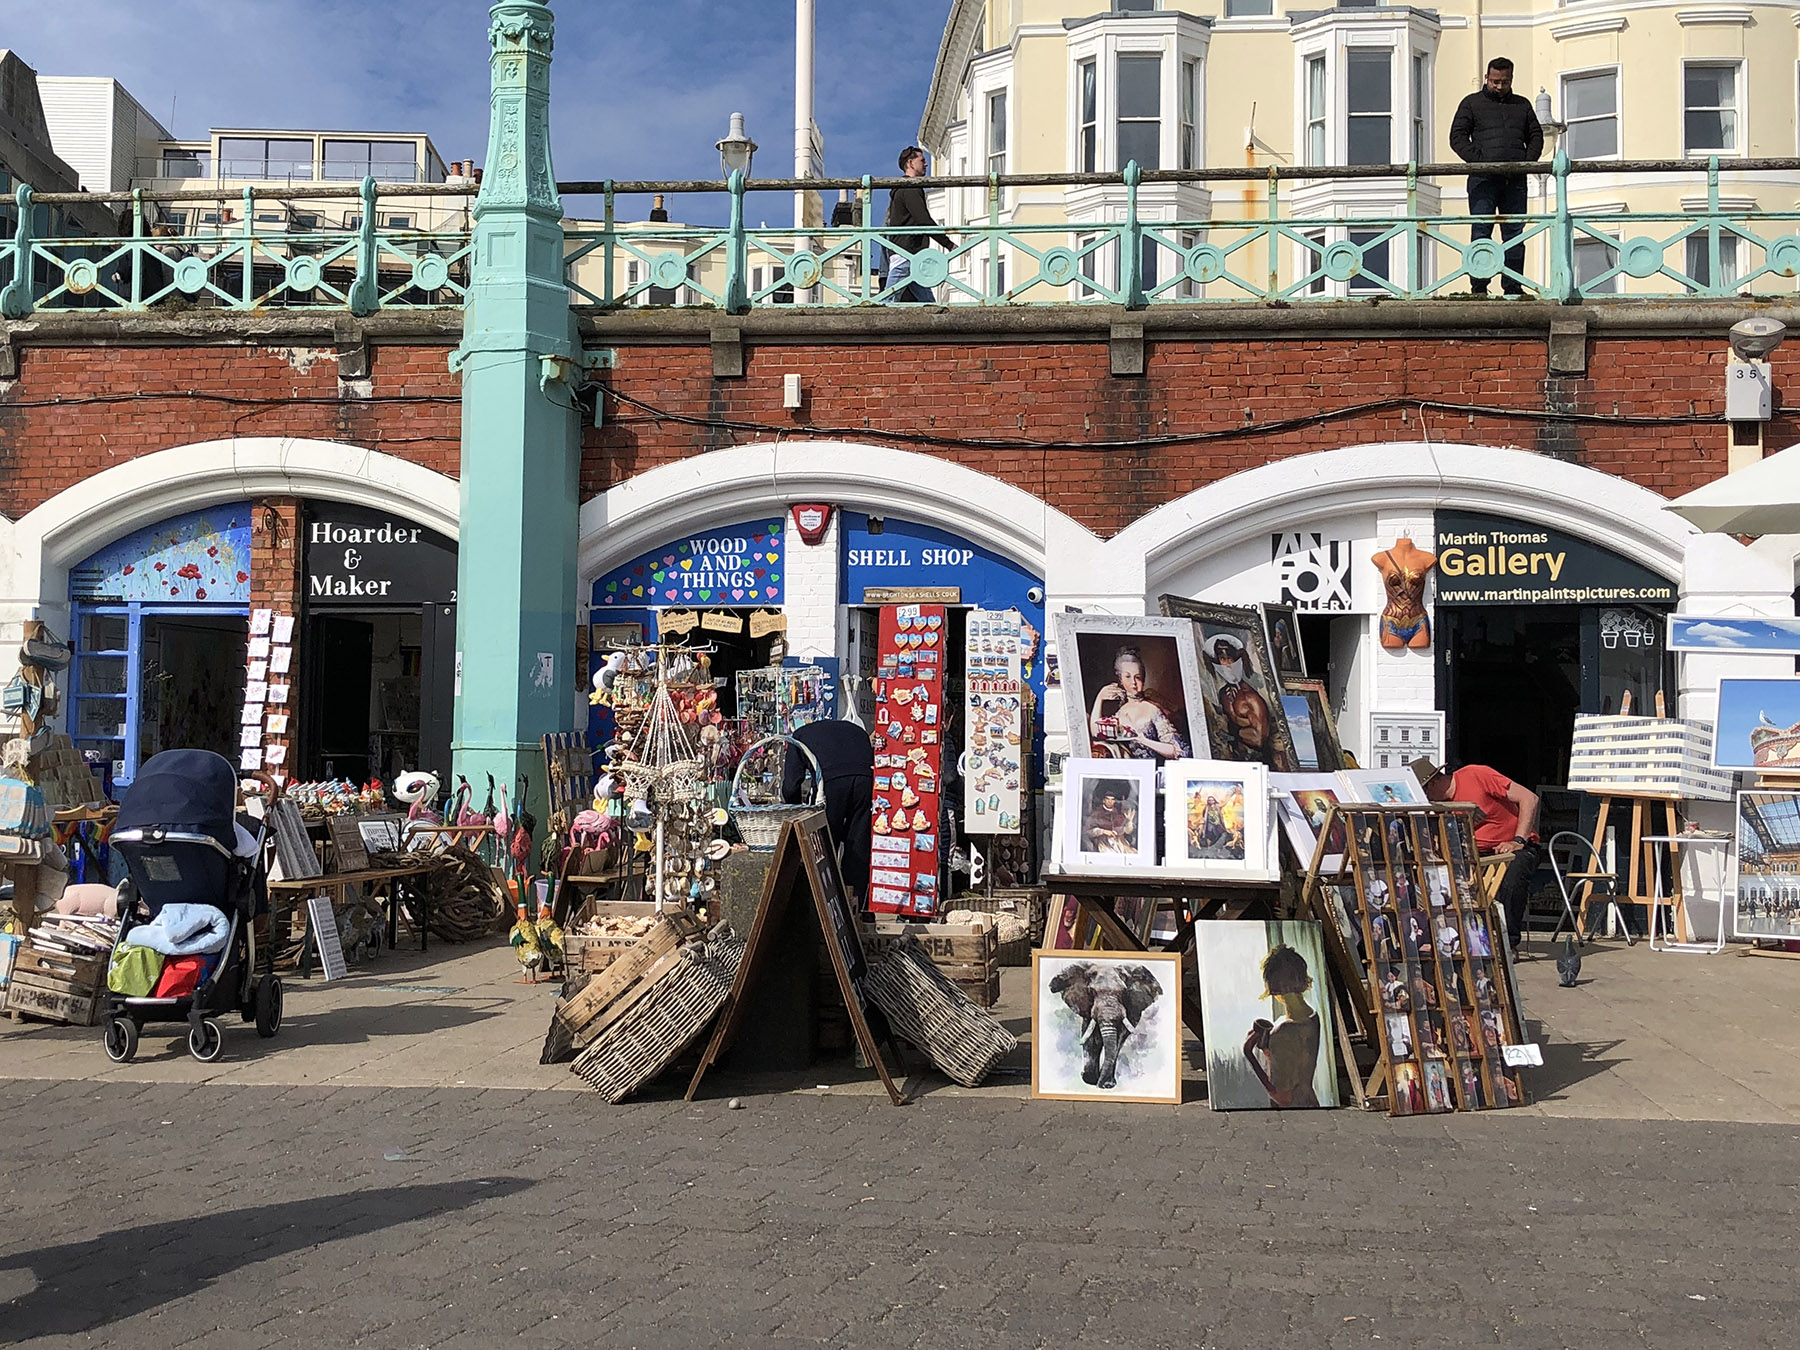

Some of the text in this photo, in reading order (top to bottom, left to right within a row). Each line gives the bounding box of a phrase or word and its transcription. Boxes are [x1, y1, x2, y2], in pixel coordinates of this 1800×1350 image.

[310, 522, 422, 544] Hoarder
[1439, 532, 1548, 546] Martin Thomas
[690, 537, 747, 555] WOOD
[343, 548, 362, 570] &
[700, 554, 741, 572] AND
[848, 548, 974, 566] SHELL SHOP
[1439, 545, 1566, 582] Gallery
[309, 574, 392, 596] Maker
[680, 571, 755, 589] THINGS
[1281, 565, 1352, 601] FOX
[1440, 586, 1671, 602] www.martinpaintspictures.com
[1271, 600, 1352, 611] ALLERY
